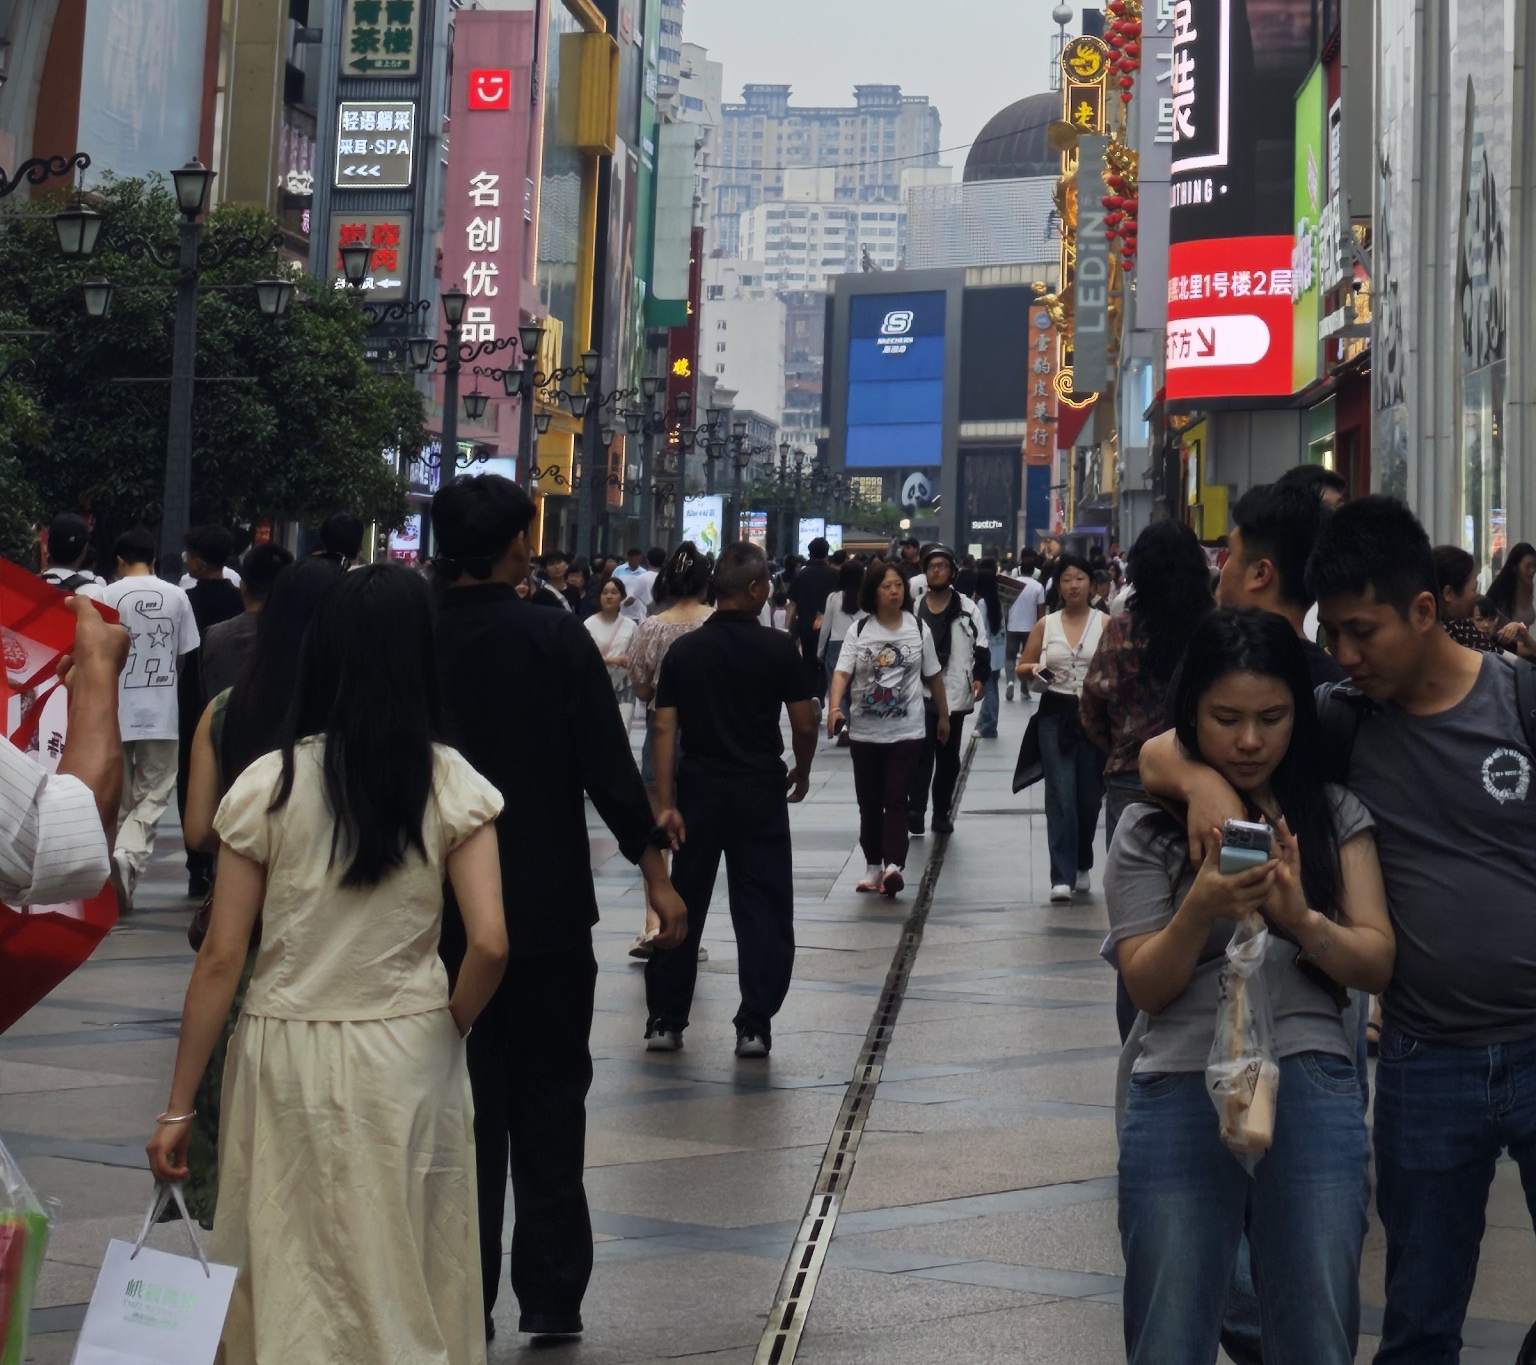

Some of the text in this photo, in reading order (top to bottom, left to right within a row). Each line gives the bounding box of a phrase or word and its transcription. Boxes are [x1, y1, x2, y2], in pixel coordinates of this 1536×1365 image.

[350, 27, 413, 54] 茶楼
[461, 171, 501, 343] 名创优品
[1166, 329, 1192, 359] 下方
[971, 520, 998, 529] swatch
